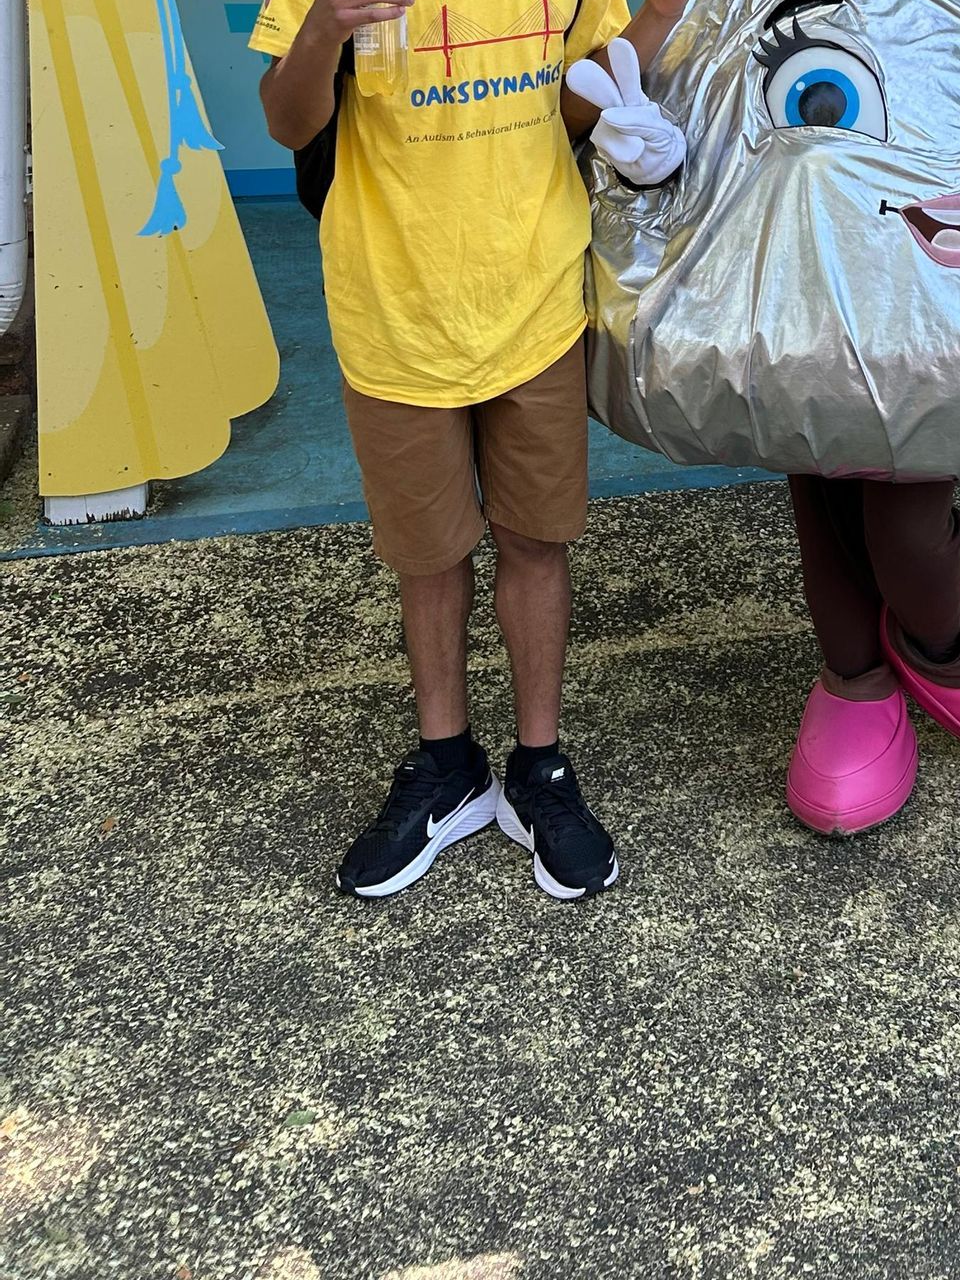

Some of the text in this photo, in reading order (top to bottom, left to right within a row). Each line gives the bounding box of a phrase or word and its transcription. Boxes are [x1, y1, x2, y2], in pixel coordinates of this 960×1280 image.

[410, 80, 470, 108] OAKS
[405, 117, 541, 144] An Autism & Behavioral Health
